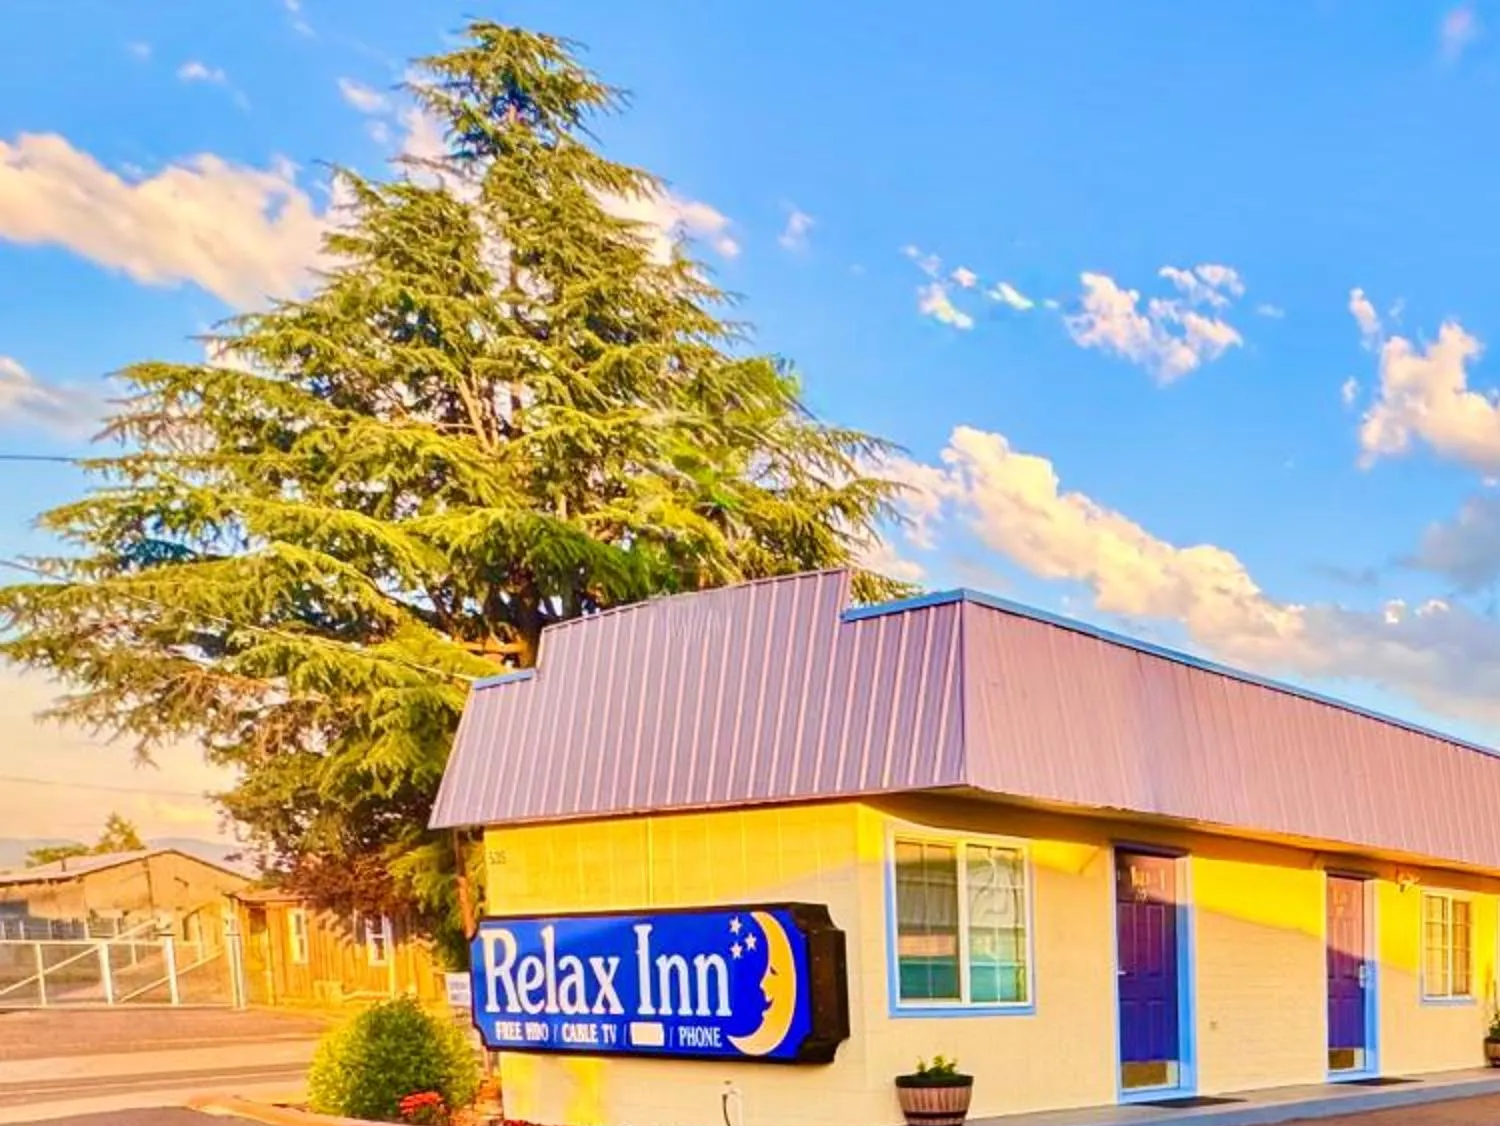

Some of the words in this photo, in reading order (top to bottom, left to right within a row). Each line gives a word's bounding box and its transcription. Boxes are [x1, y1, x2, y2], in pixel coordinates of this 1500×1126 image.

[480, 927, 625, 1014] Relax
[632, 923, 733, 1017] Inn
[495, 1021, 523, 1041] FREE
[561, 1022, 599, 1043] CABLE
[601, 1023, 617, 1044] TV
[678, 1026, 722, 1048] PHONE
